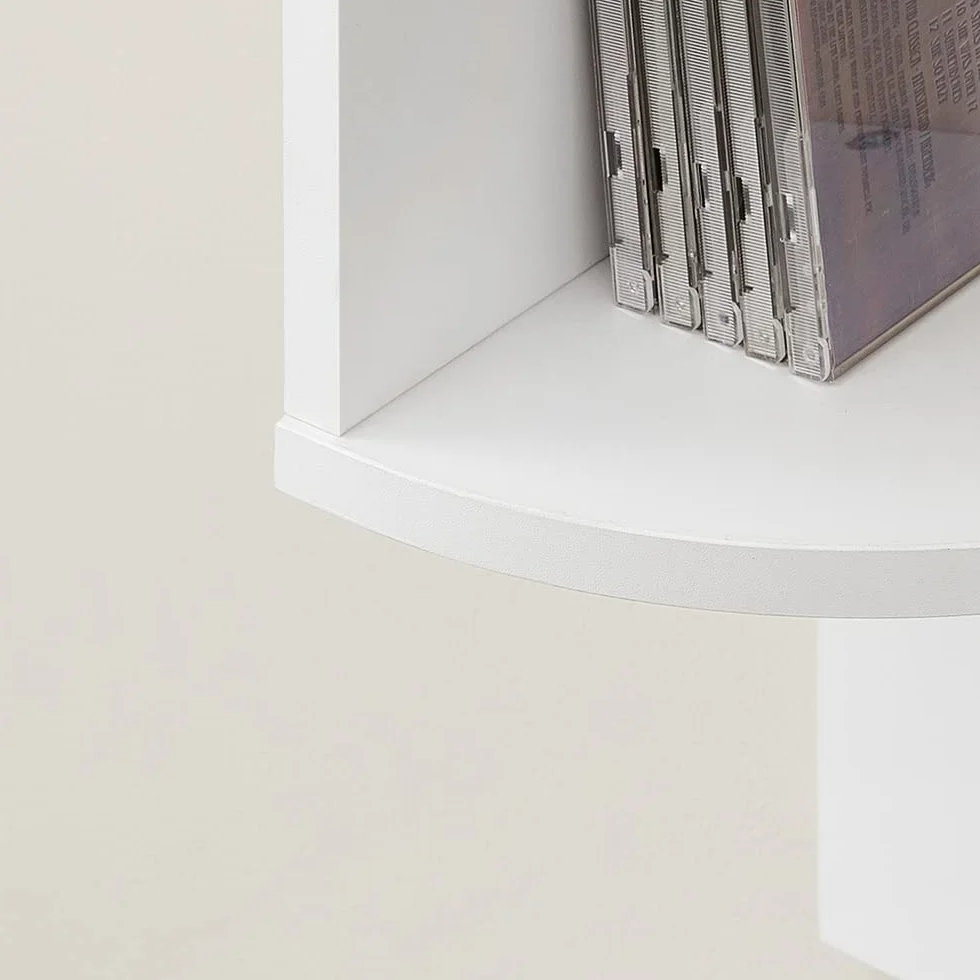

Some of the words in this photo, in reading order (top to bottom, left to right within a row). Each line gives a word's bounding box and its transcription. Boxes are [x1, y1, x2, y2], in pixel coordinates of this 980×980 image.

[955, 0, 966, 17] 10
[942, 9, 952, 25] 11
[928, 18, 938, 34] 12
